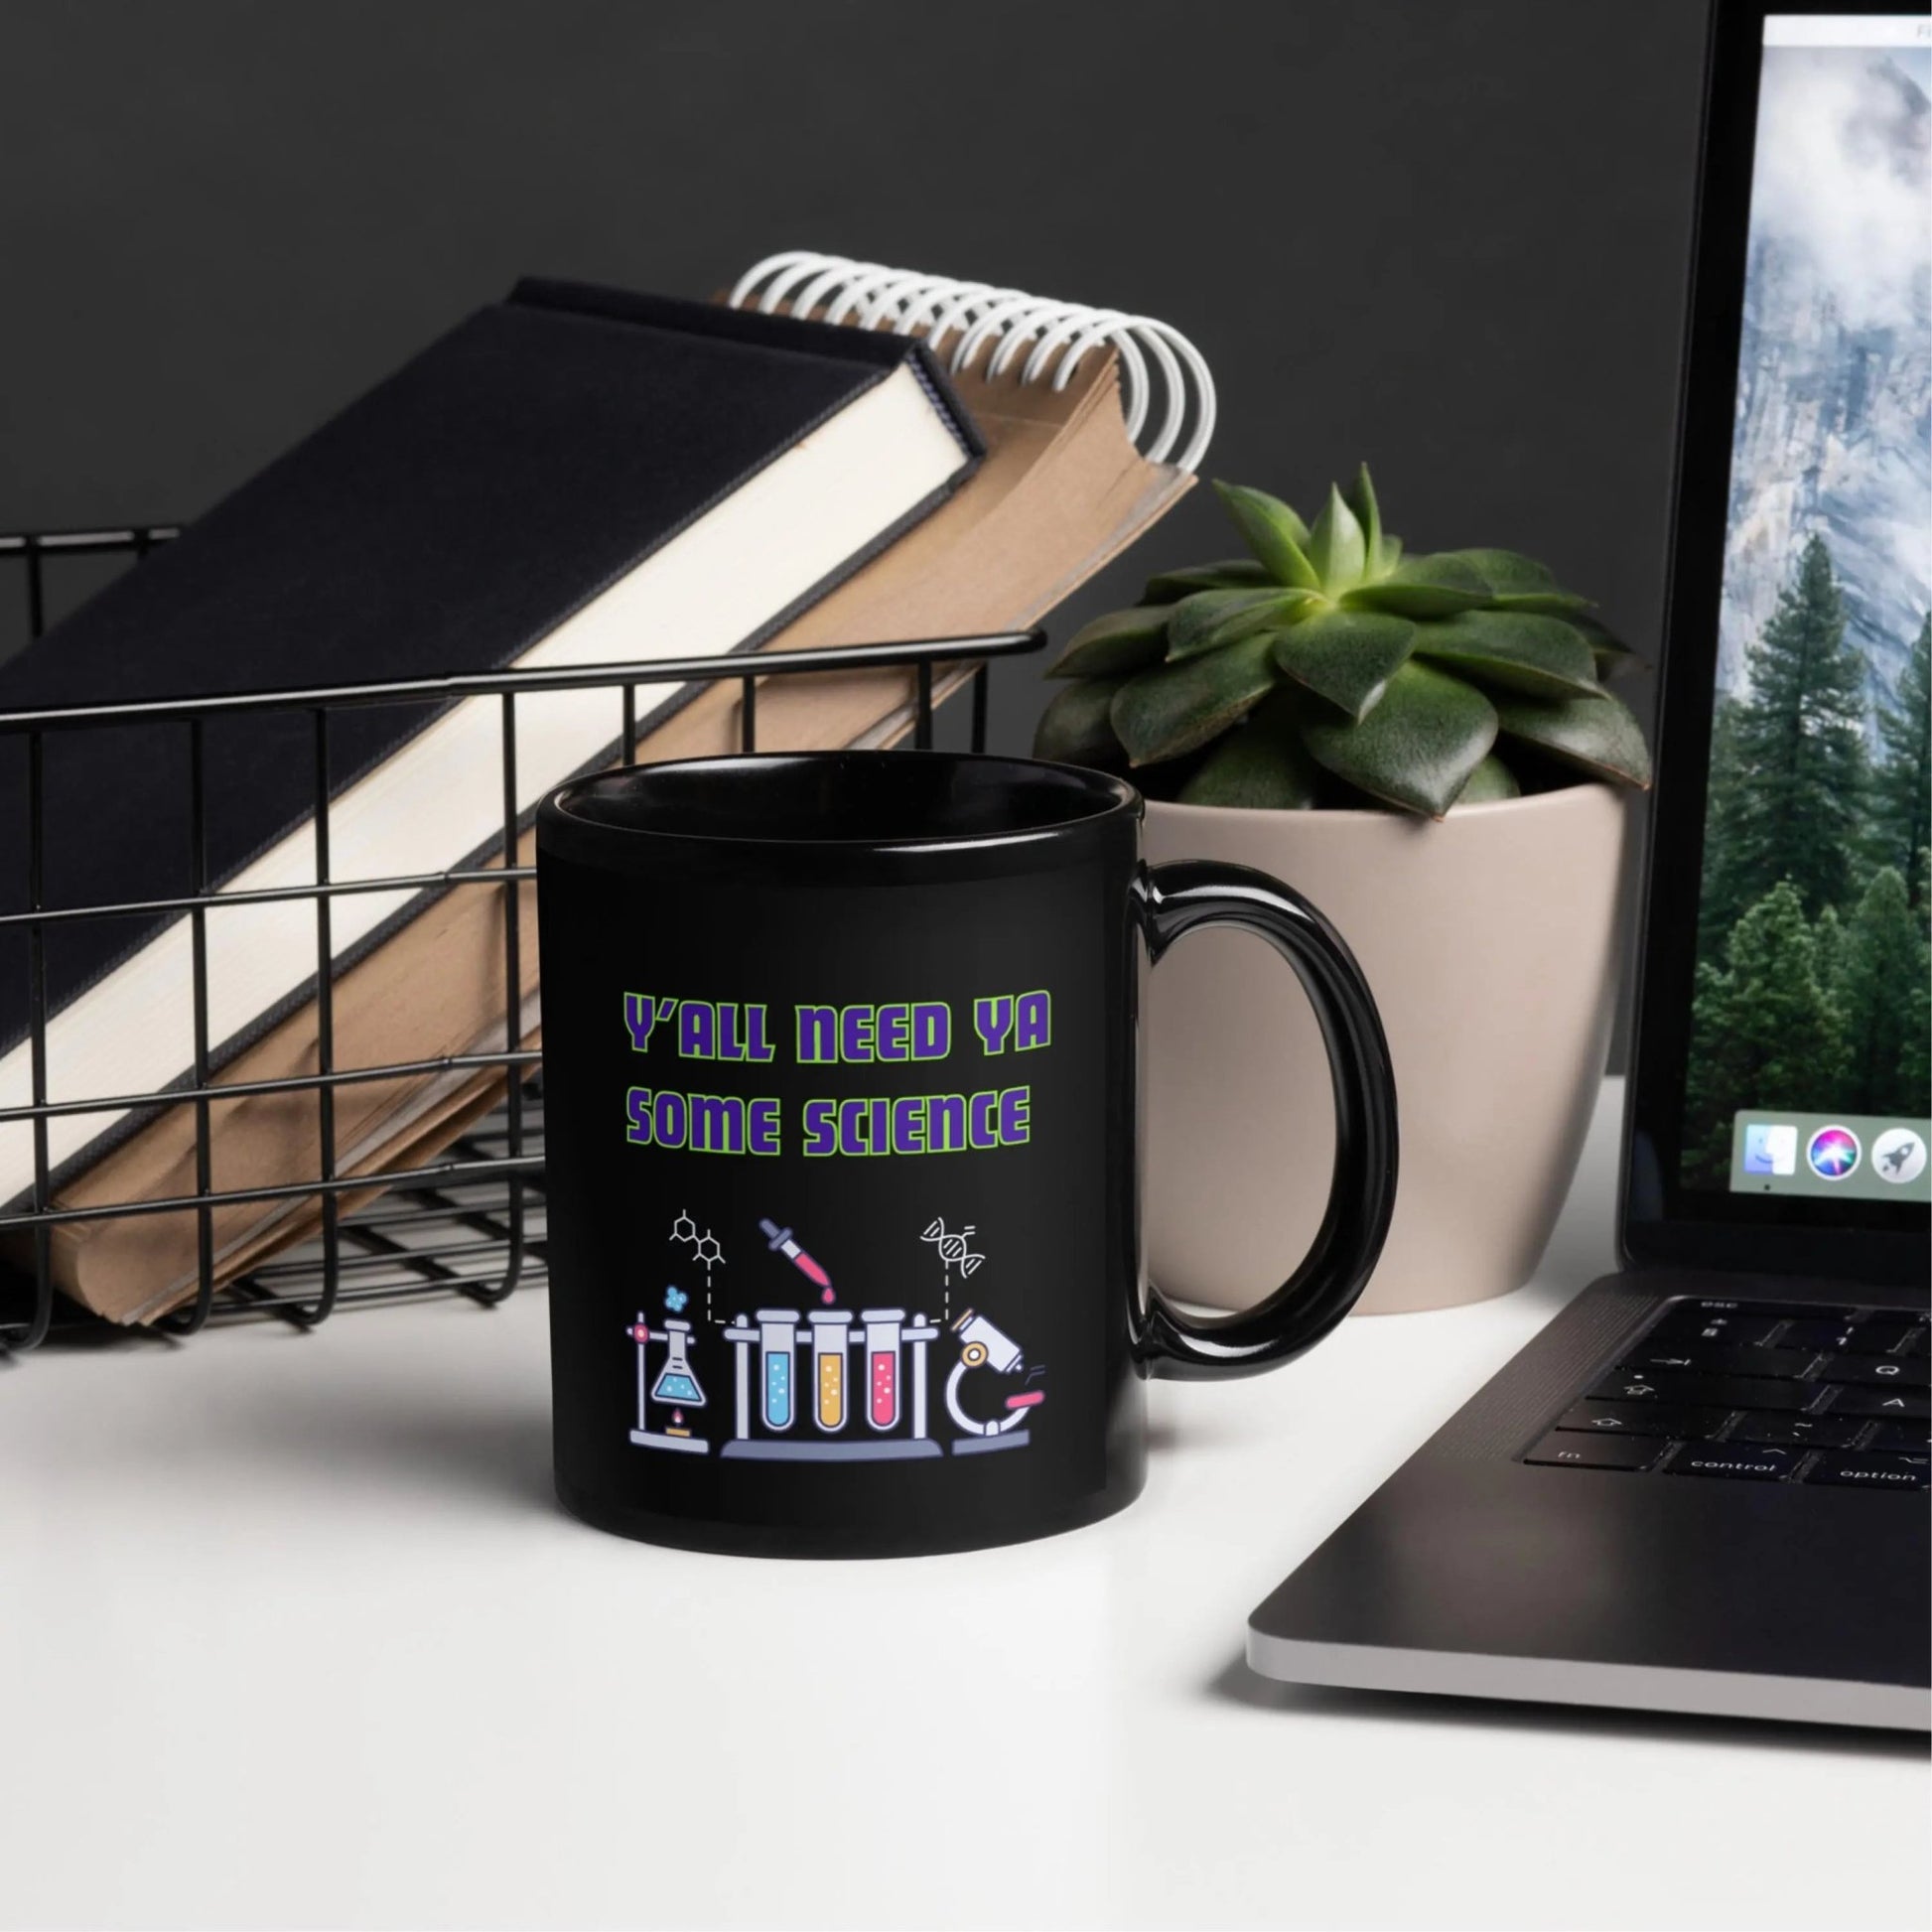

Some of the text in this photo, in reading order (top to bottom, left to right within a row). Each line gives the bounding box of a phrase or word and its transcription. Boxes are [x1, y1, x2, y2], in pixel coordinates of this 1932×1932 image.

[795, 1002, 951, 1063] NEED
[973, 990, 1050, 1055] YA
[626, 1085, 1030, 1157] SOME SCIENCE
[1875, 1365, 1900, 1376] Q
[1881, 1398, 1905, 1408] A
[1691, 1460, 1777, 1471] control
[1840, 1470, 1916, 1481] option
